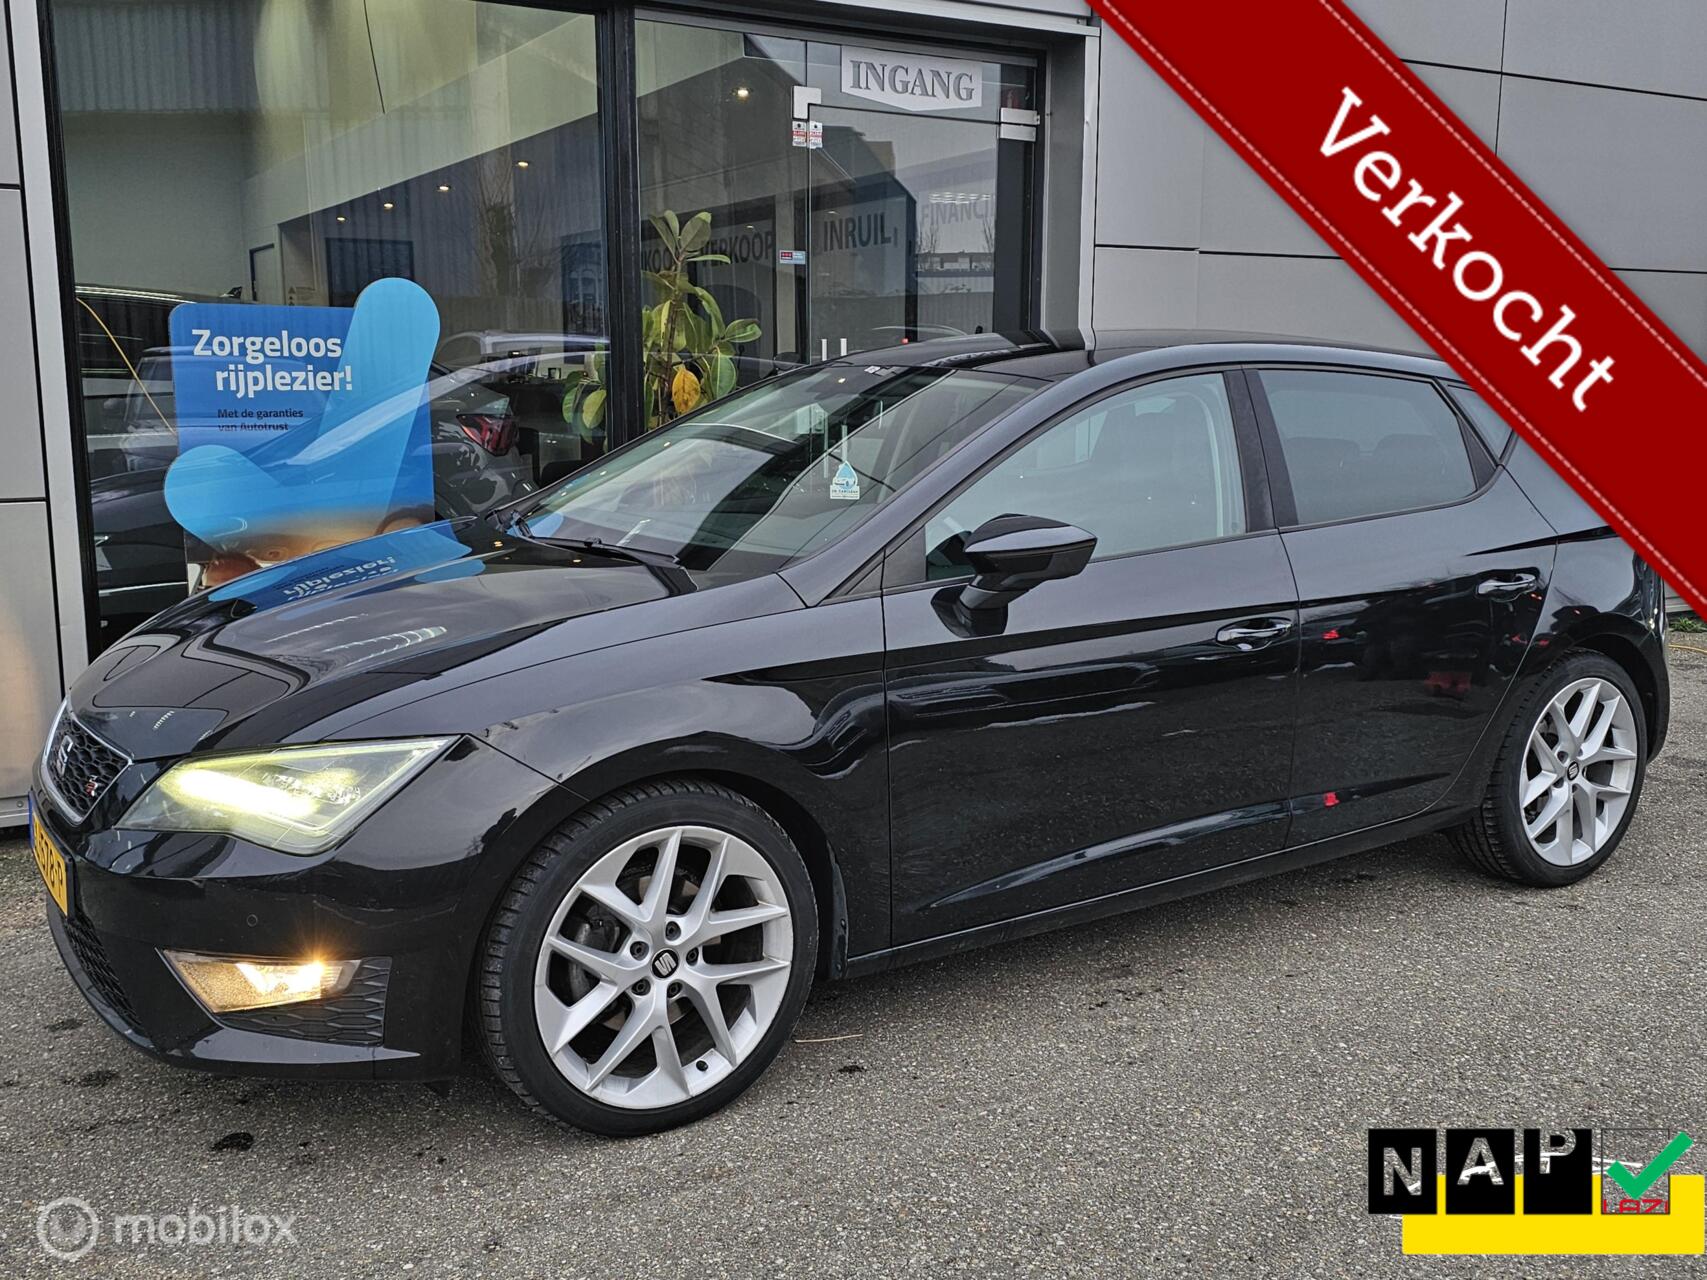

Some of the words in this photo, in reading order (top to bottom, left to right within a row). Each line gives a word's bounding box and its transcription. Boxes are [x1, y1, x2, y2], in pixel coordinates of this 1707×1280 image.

[850, 60, 975, 100] INGANG
[823, 212, 892, 251] INRUIL
[191, 329, 342, 364] Zorgeloos
[215, 364, 353, 398] rijplezier!
[217, 408, 239, 418] Met
[241, 408, 254, 418] de
[256, 408, 304, 420] garanties
[240, 423, 289, 431] Autotrust
